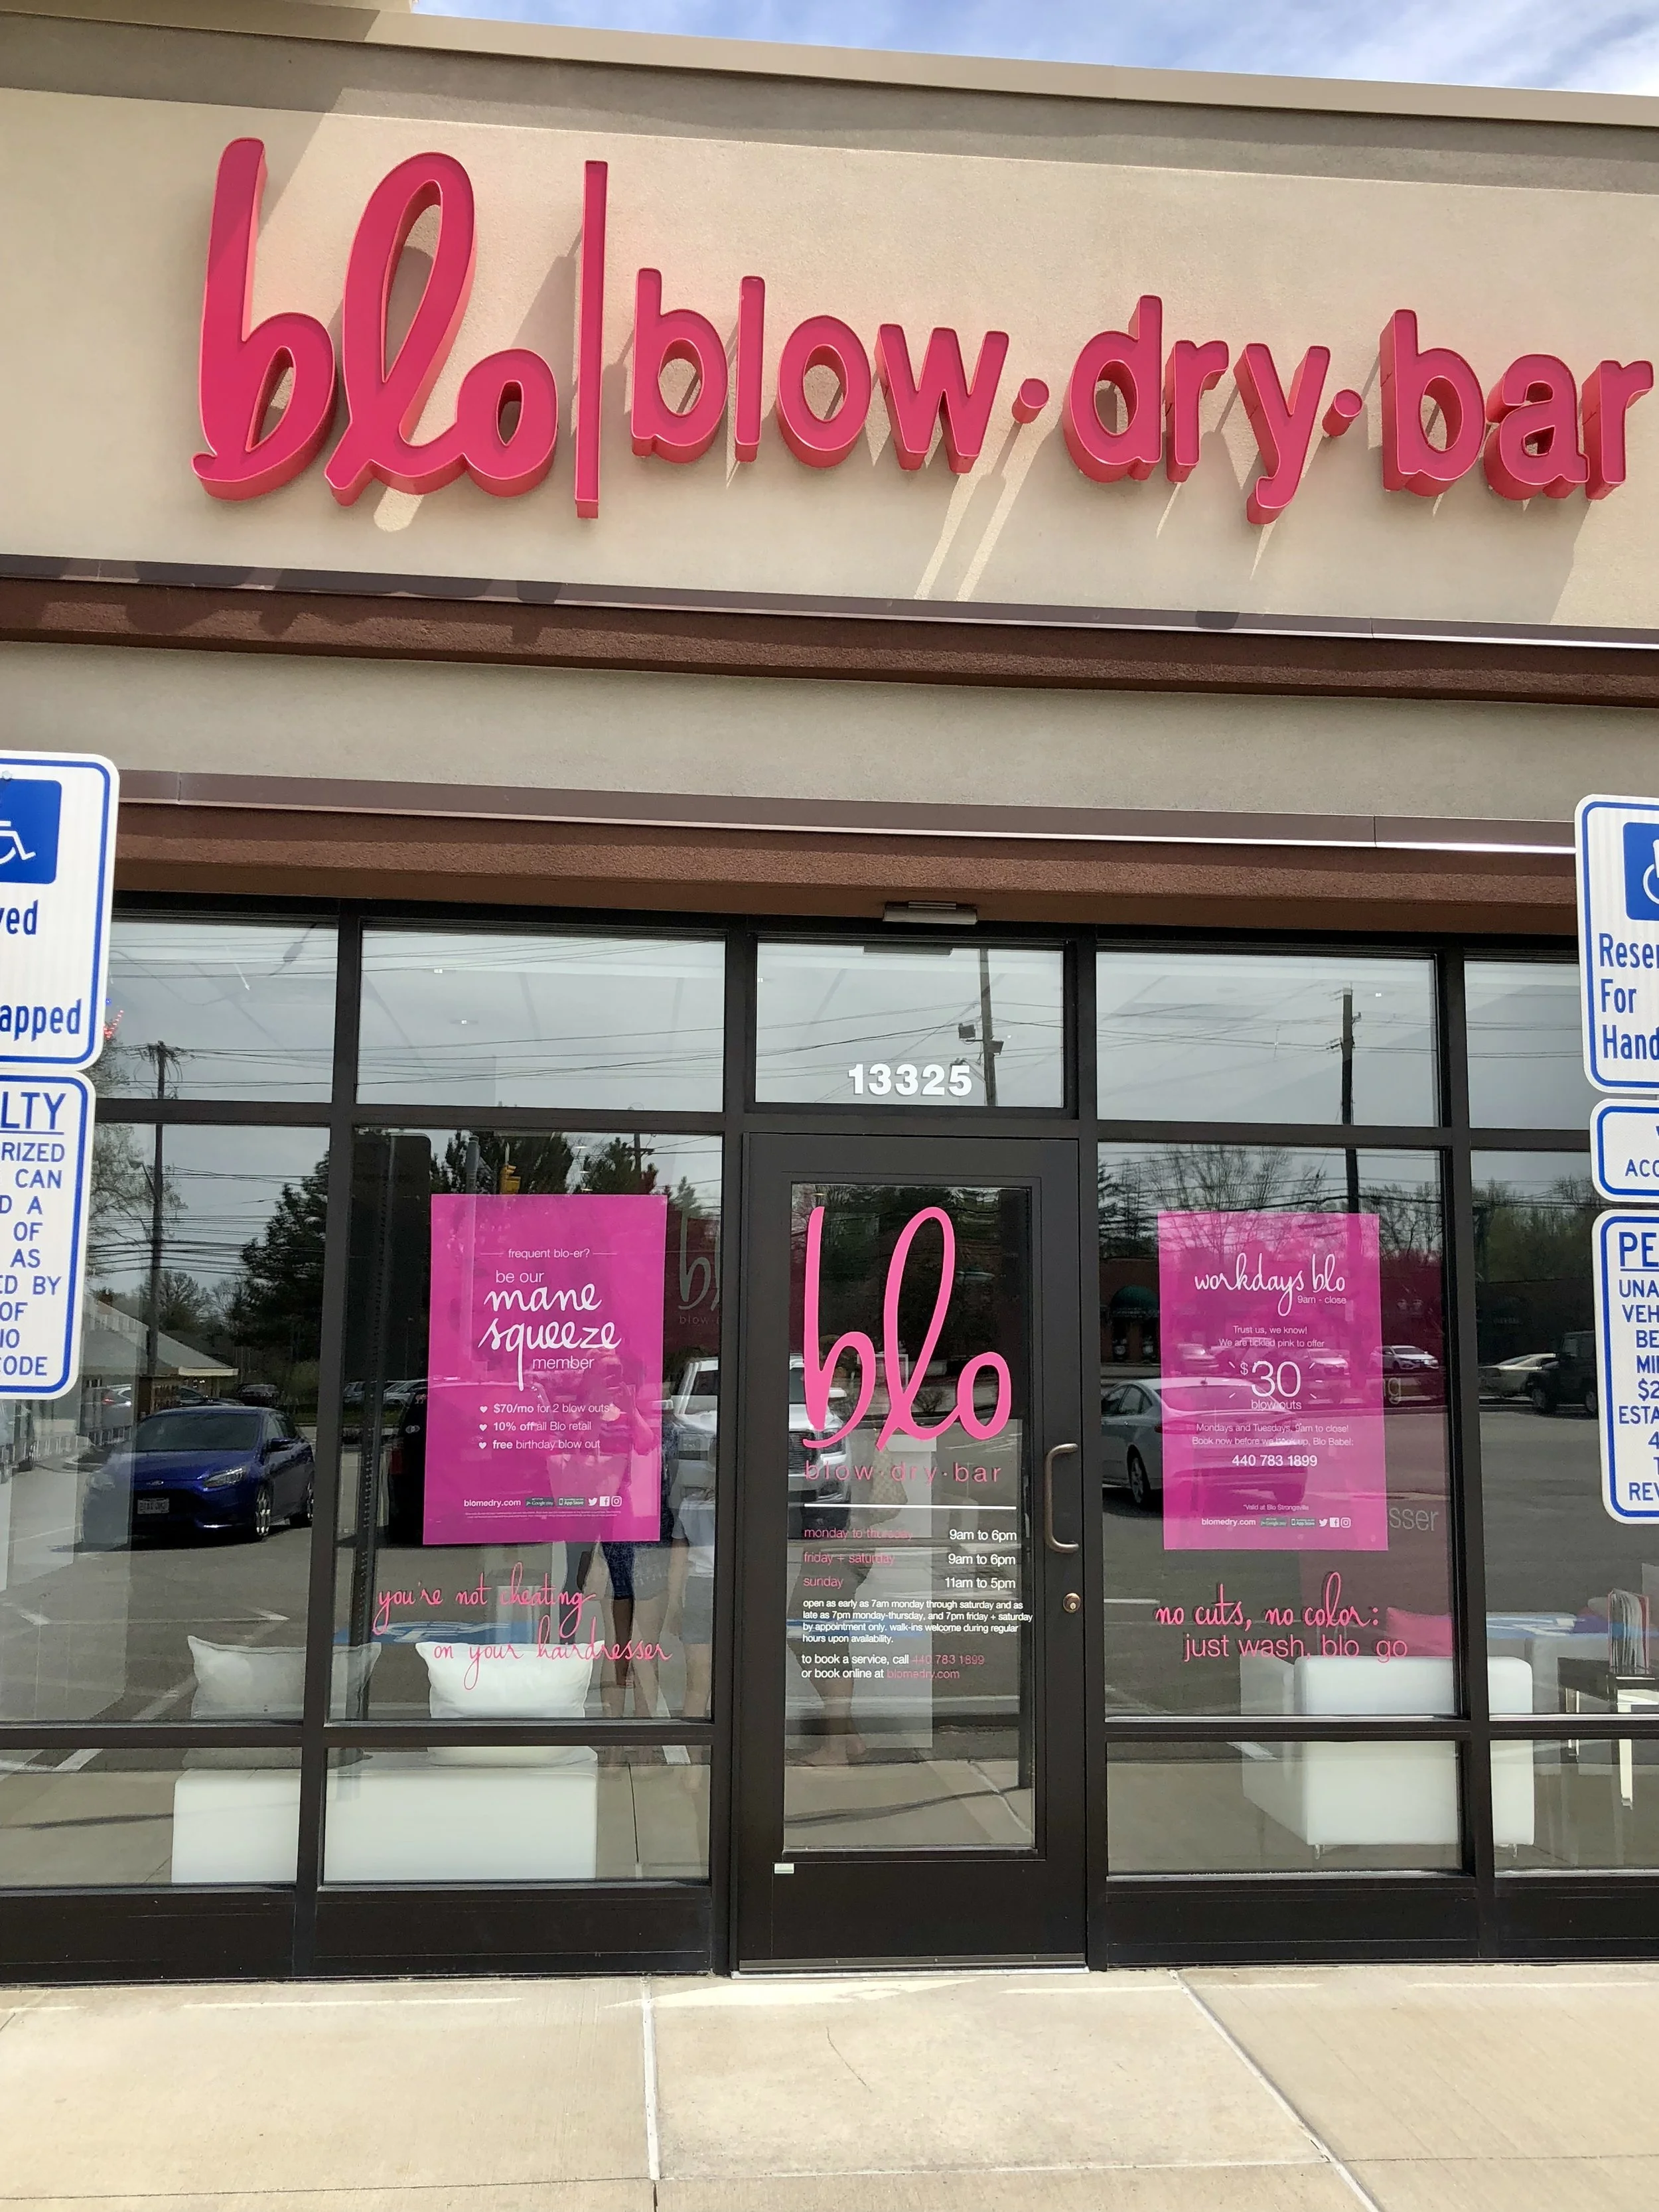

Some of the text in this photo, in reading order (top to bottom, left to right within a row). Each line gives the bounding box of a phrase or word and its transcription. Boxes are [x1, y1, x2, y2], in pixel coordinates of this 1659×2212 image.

[192, 137, 559, 506] blo
[1601, 978, 1637, 1013] For
[0, 998, 81, 1042] apped
[848, 1063, 973, 1096] 13325
[1, 1092, 66, 1130] LTY
[1, 1142, 65, 1162] RIZED
[15, 1169, 62, 1189] CAN
[27, 1196, 42, 1215] A
[13, 1222, 42, 1241] OF
[508, 1248, 591, 1260] frequent blo-er?
[1619, 1232, 1658, 1267] PE
[10, 1248, 40, 1268] AS
[496, 1270, 544, 1284] be our
[1194, 1252, 1346, 1317] workdays blo
[33, 1276, 62, 1295] BY
[1619, 1280, 1659, 1297] UNA
[483, 1283, 602, 1311] mane
[1297, 1295, 1347, 1305] 9am close
[0, 1301, 28, 1321] OF
[803, 1207, 1011, 1451] blo
[1232, 1325, 1254, 1335] Trust
[1255, 1327, 1267, 1336] us,
[1283, 1325, 1308, 1335] know!
[1218, 1338, 1232, 1347] We
[1249, 1338, 1275, 1347] tickled
[1277, 1338, 1294, 1349] pink
[1307, 1338, 1325, 1347] offer
[1636, 1330, 1659, 1348] BE
[478, 1318, 621, 1390] squeeze
[0, 1356, 48, 1376] ODE
[532, 1355, 594, 1370] member
[493, 1403, 611, 1414] $70/mo for 2 blow outs
[1251, 1400, 1302, 1410] blow outs
[493, 1422, 592, 1432] 10% off all Blo retail
[1196, 1423, 1233, 1433] Mondays
[1236, 1424, 1251, 1432] and
[1295, 1424, 1313, 1433] 9am
[492, 1440, 601, 1451] free birthday blow out
[1192, 1436, 1213, 1445] Book
[1234, 1436, 1260, 1445] before
[1313, 1437, 1327, 1445] Blo
[1232, 1454, 1318, 1467] 440 783 1899
[464, 1499, 521, 1508] blomedry.com
[1201, 1518, 1256, 1527] blomedry.com
[804, 1528, 848, 1540] monday
[852, 1528, 863, 1538] to
[949, 1528, 974, 1540] 9am
[977, 1530, 989, 1540] to
[991, 1529, 1017, 1543] 6pm
[804, 1552, 1016, 1567] friday saturday 9am to 6pm
[803, 1576, 1016, 1591] sunday 11am to 5pm
[372, 1561, 597, 1639] you're not cheating
[803, 1600, 824, 1609] open
[838, 1599, 857, 1609] early
[871, 1599, 889, 1608] 7am
[891, 1600, 924, 1610] monday
[926, 1600, 958, 1610] through
[959, 1601, 994, 1611] saturday
[995, 1601, 1011, 1609] and
[1155, 1606, 1185, 1626] no
[1194, 1583, 1252, 1631] cuts,
[1264, 1606, 1295, 1627] no
[802, 1611, 818, 1619] late
[832, 1611, 851, 1621] 7pm
[852, 1611, 926, 1622] monday-thursday,
[946, 1612, 965, 1621] 7pm
[966, 1612, 988, 1622] friday
[998, 1613, 1033, 1623] saturday
[802, 1623, 813, 1632] by
[815, 1623, 866, 1632] appointment
[868, 1623, 887, 1633] only.
[889, 1623, 923, 1632] walk-ins
[963, 1624, 989, 1634] during
[990, 1625, 1019, 1634] regular
[828, 1635, 849, 1644] upon
[851, 1635, 894, 1645] availability.
[1184, 1633, 1407, 1663] just wash, blo go
[433, 1614, 673, 1690] on your hairdresser
[801, 1654, 812, 1664] to
[814, 1654, 841, 1664] book
[851, 1654, 890, 1665] service,
[892, 1654, 909, 1664] call
[935, 1655, 956, 1664] 783
[959, 1655, 985, 1665] 1899
[801, 1668, 960, 1680] or book online at blomedry.com
